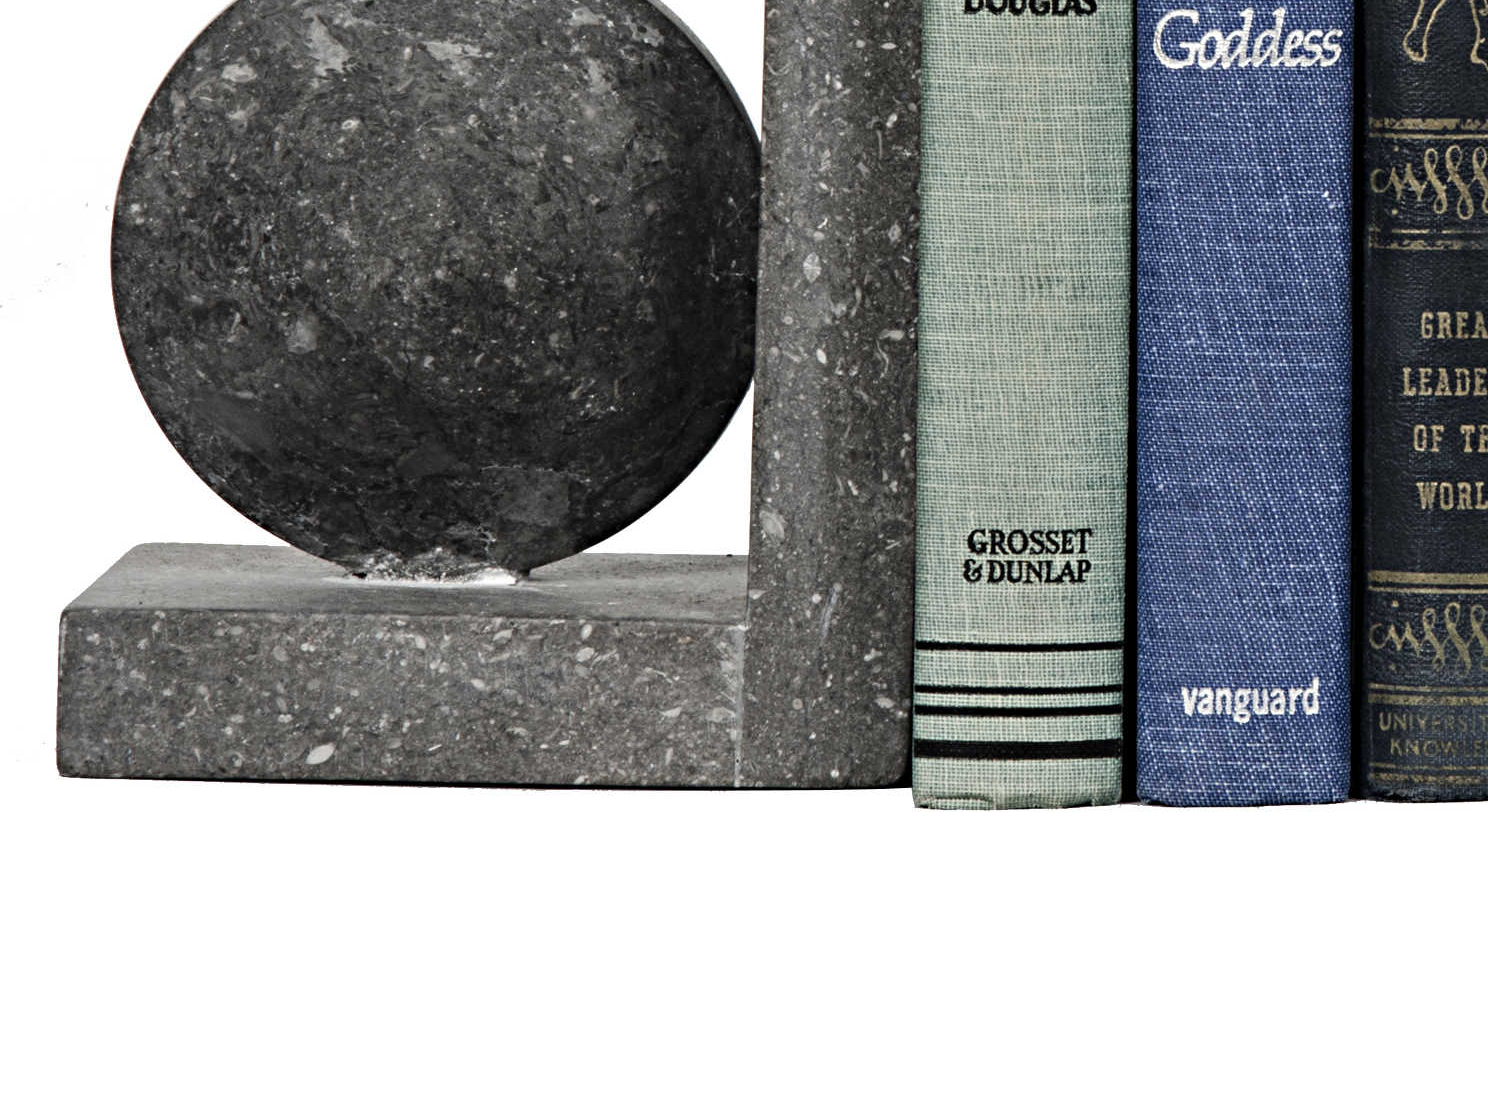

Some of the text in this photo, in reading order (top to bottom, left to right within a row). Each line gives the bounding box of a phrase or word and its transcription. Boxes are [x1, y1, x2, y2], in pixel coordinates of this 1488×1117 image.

[1153, 7, 1343, 70] Goddess
[1413, 424, 1446, 454] OF
[967, 528, 1093, 556] GROSSET
[987, 559, 1093, 584] DUNLAP
[1181, 677, 1320, 723] vanguard
